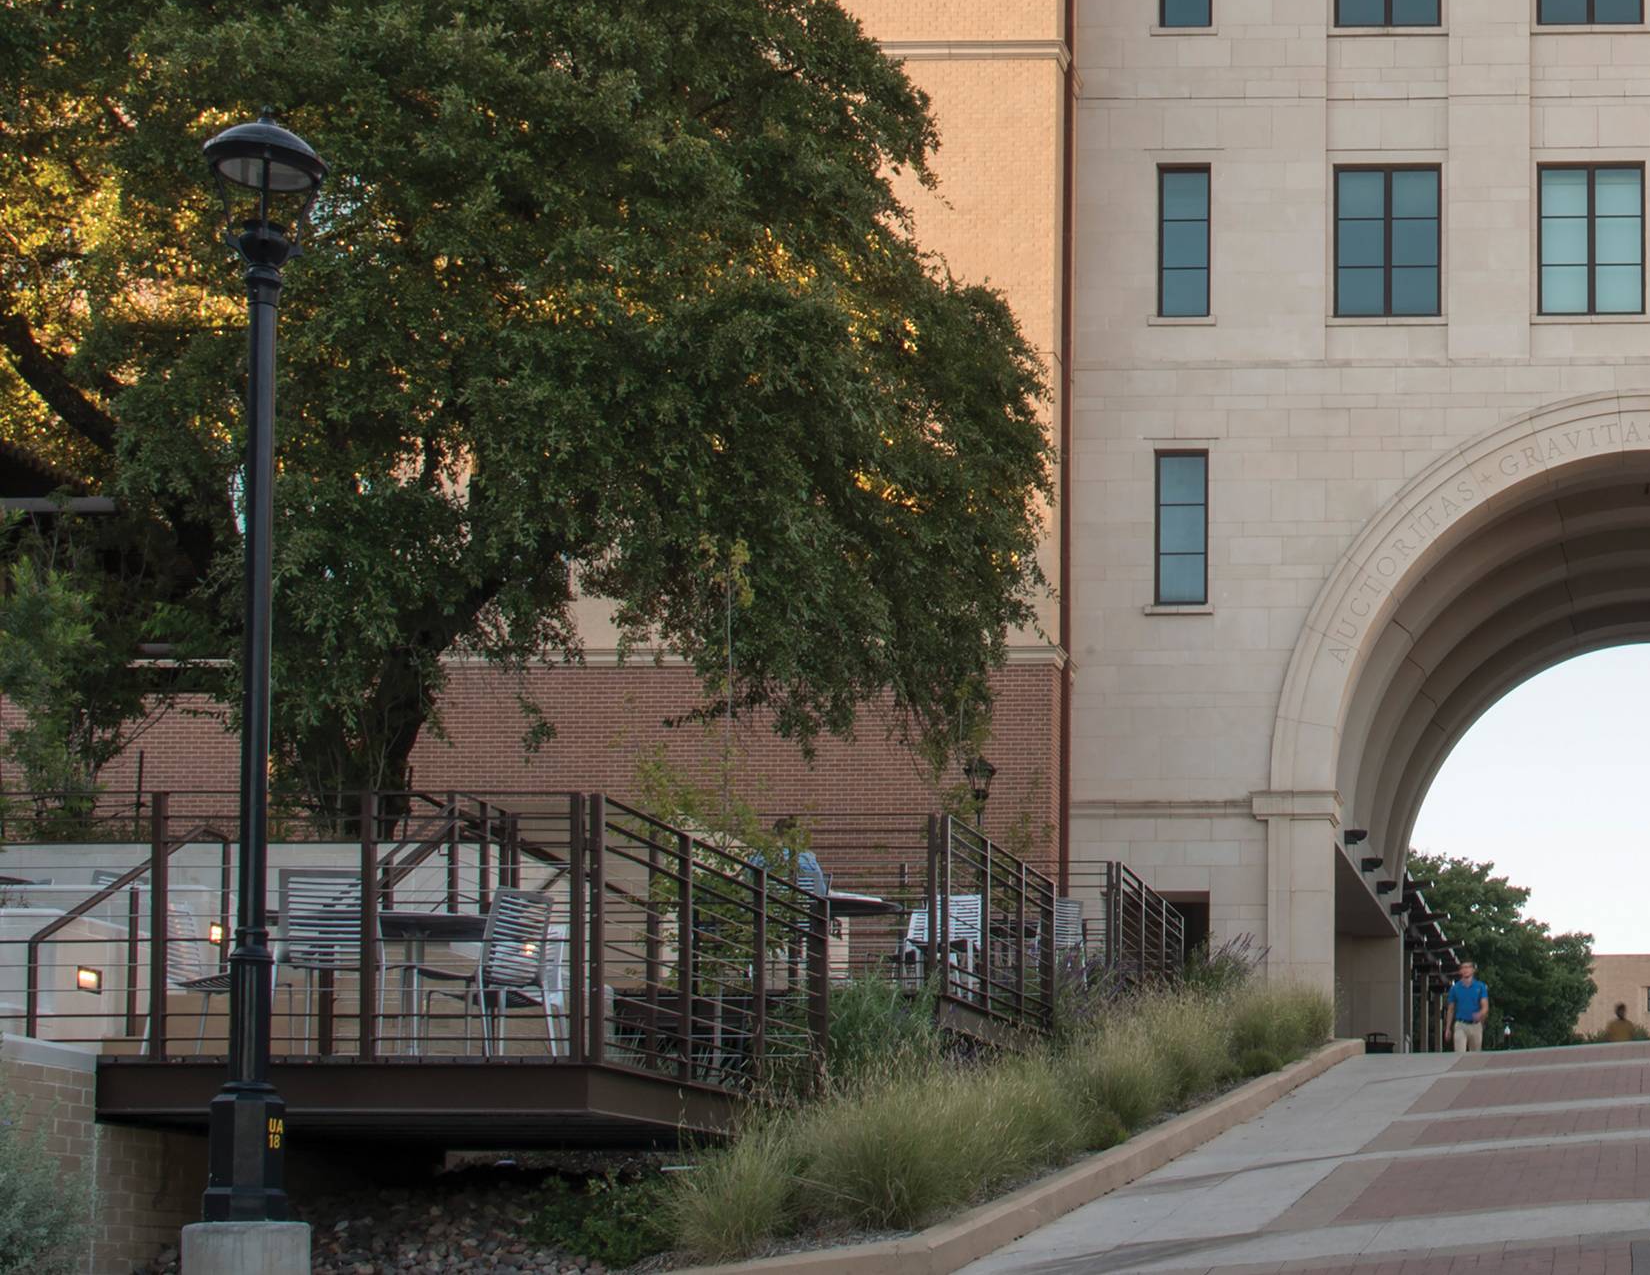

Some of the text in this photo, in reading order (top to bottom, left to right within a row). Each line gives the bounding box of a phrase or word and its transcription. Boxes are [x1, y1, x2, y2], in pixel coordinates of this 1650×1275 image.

[1327, 479, 1476, 668] AUCTORITAS
[269, 1117, 284, 1134] UA
[269, 1134, 281, 1149] 18
